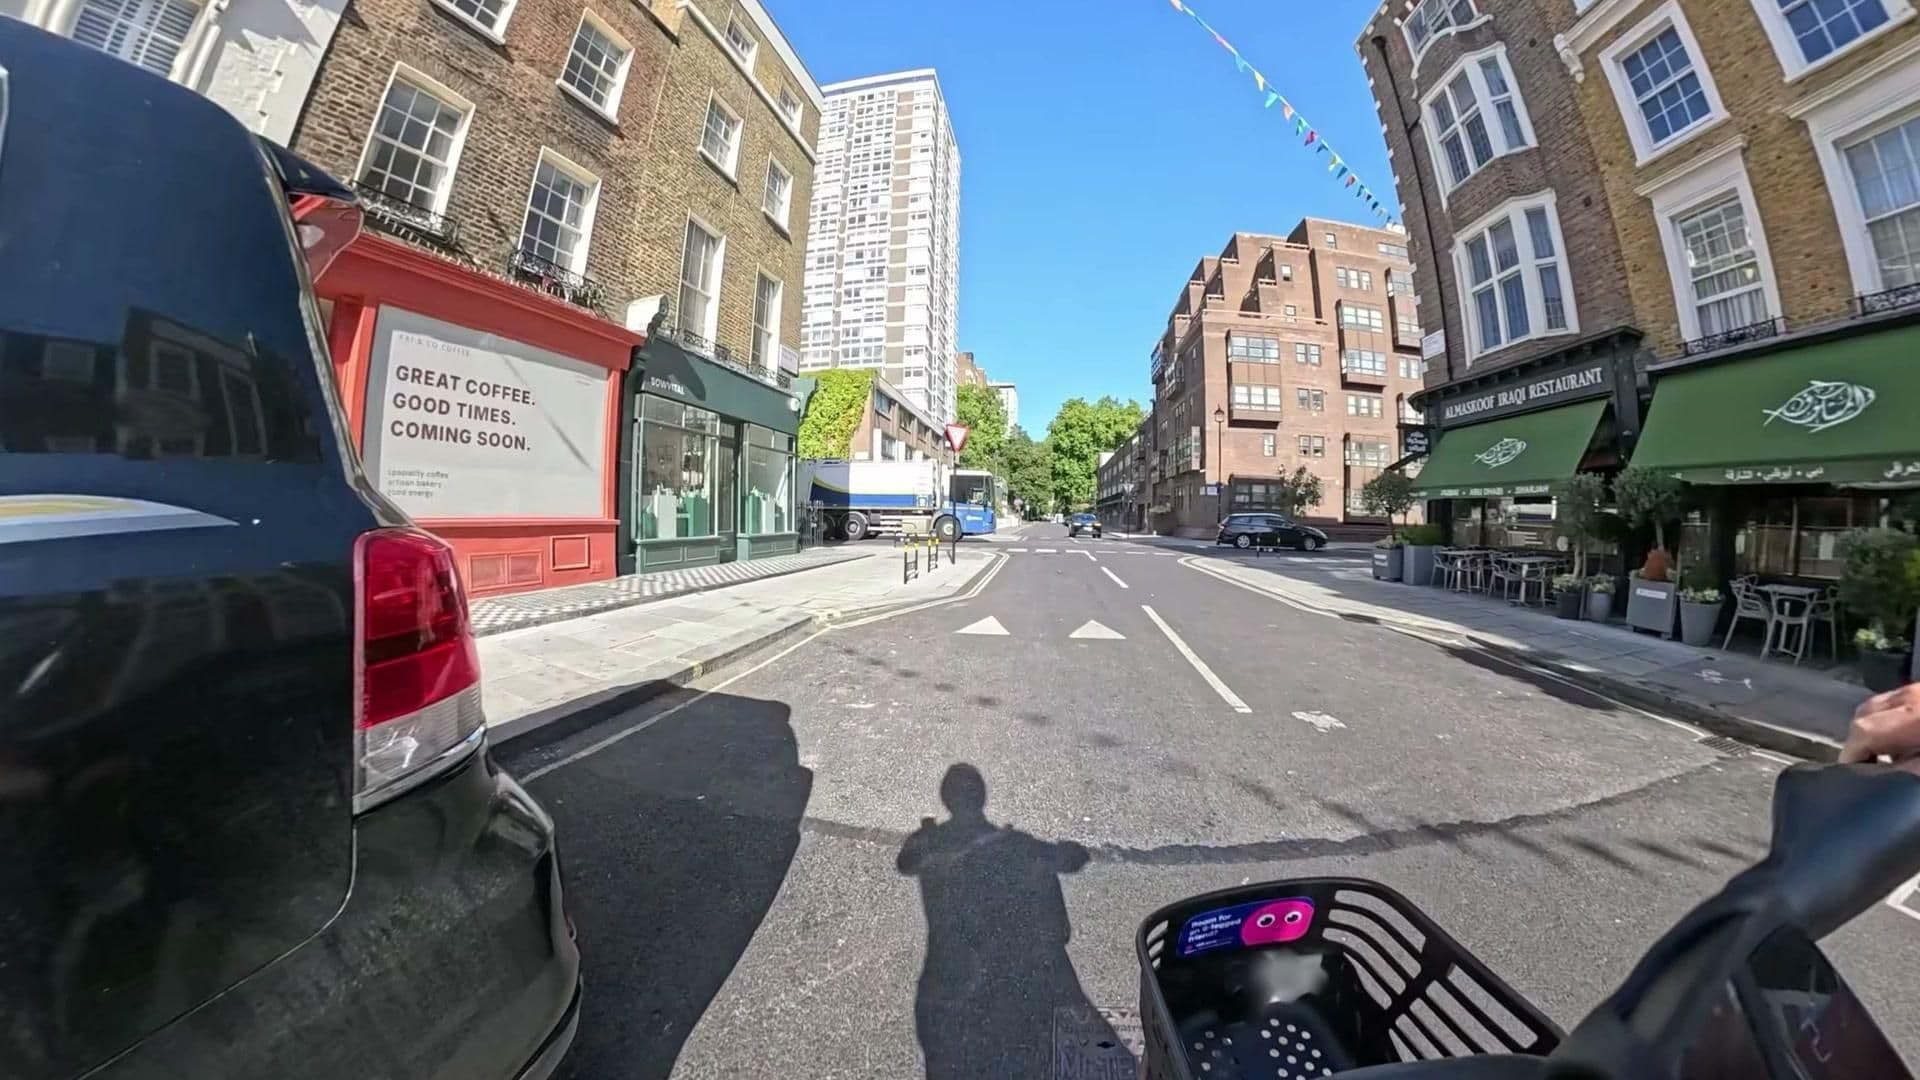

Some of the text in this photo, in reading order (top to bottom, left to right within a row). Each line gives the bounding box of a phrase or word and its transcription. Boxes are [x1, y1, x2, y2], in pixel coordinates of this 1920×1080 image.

[396, 365, 536, 406] GREAT COFFEE.
[1445, 368, 1603, 419] ALMASKOOF IRAQI RESTAURANT
[392, 392, 517, 426] GOOD TIMES.
[391, 420, 532, 451] COMING SOON.
